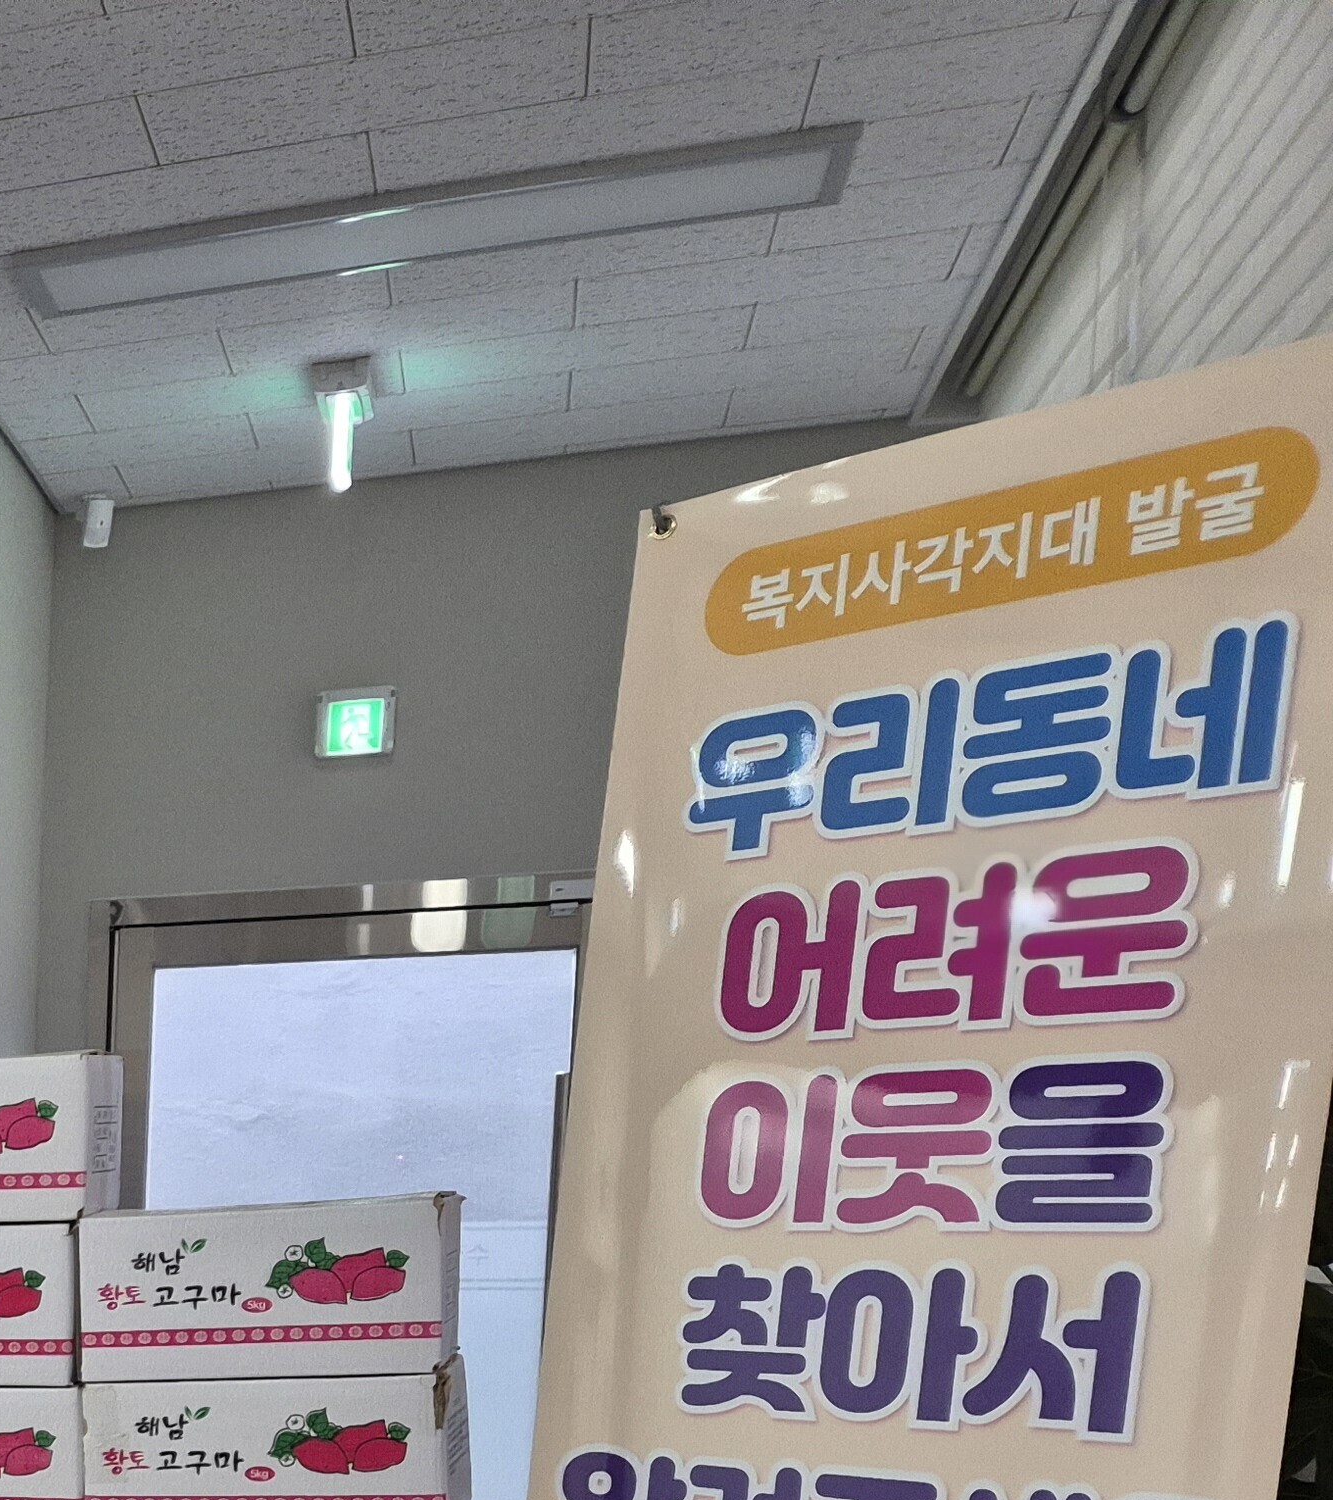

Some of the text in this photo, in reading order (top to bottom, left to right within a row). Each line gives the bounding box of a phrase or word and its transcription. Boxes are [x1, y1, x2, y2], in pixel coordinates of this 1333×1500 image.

[740, 461, 1265, 629] 복지사각지대 발굴
[686, 614, 1293, 857] 우리동네
[717, 843, 1192, 1036] 어려운
[699, 1059, 1167, 1227] 이웃을
[98, 1282, 241, 1308] 황토 고구마
[132, 1249, 185, 1276] 해남
[680, 1261, 1144, 1435] 찾아서
